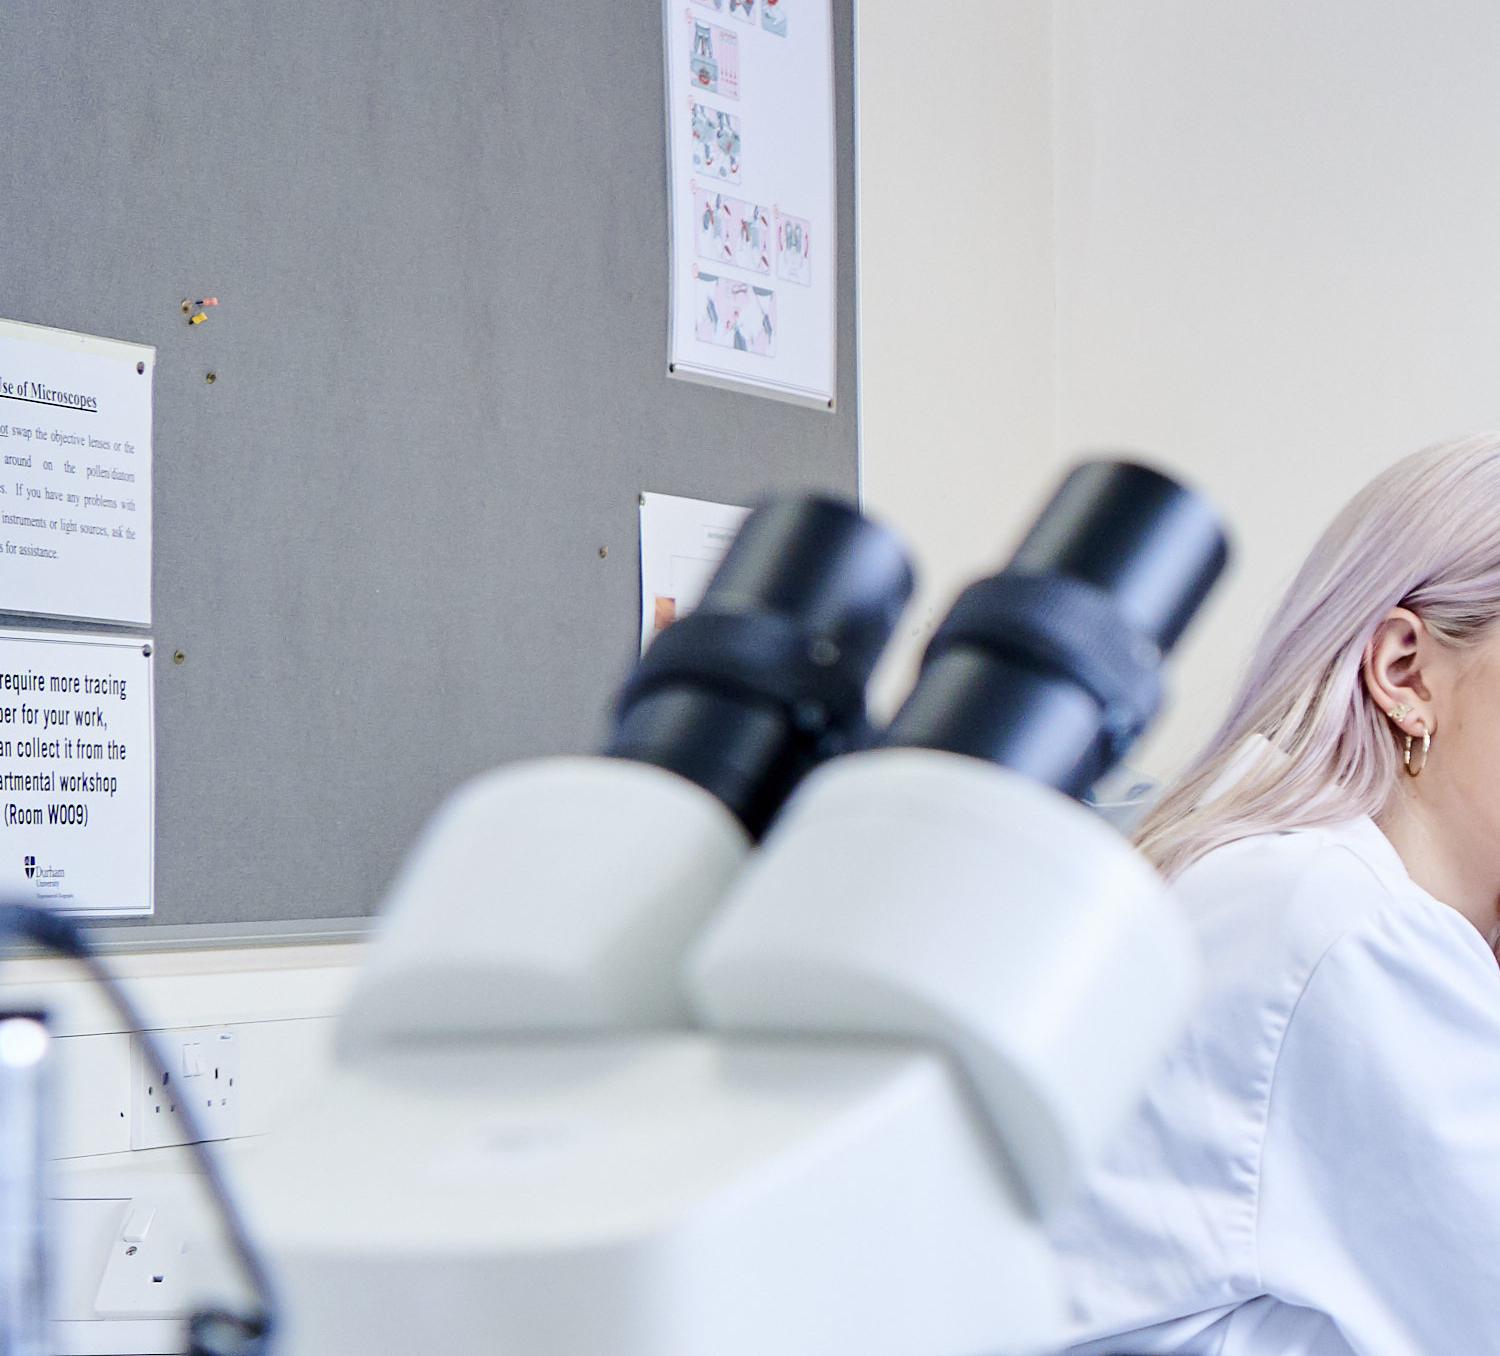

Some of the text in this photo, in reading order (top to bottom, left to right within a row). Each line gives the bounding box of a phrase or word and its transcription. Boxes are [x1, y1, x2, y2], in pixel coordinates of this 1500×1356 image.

[17, 381, 29, 397] of
[31, 382, 97, 409] Microscopes
[12, 426, 32, 441] swap
[36, 427, 47, 440] the
[51, 430, 85, 446] objective
[88, 435, 110, 450] lenses
[114, 441, 121, 451] or
[124, 441, 135, 454] the
[4, 454, 31, 468] around
[43, 460, 53, 470] on
[64, 460, 76, 474] the
[16, 483, 23, 496] If
[27, 487, 41, 500] you
[45, 487, 63, 501] have
[67, 494, 80, 506] any
[84, 495, 117, 509] problems
[2, 511, 46, 528] instruments
[49, 520, 57, 530] or
[60, 518, 77, 534] light
[6, 542, 58, 559] for assistance.
[0, 670, 127, 700] require more tracing
[22, 704, 38, 725] for
[44, 709, 70, 729] your
[75, 707, 107, 731] work,
[17, 738, 60, 759] collect
[64, 740, 72, 759] it
[77, 739, 103, 760] from
[107, 740, 126, 761] the
[60, 772, 117, 797] workshop
[5, 804, 43, 825] (Room
[36, 864, 65, 878] Durham
